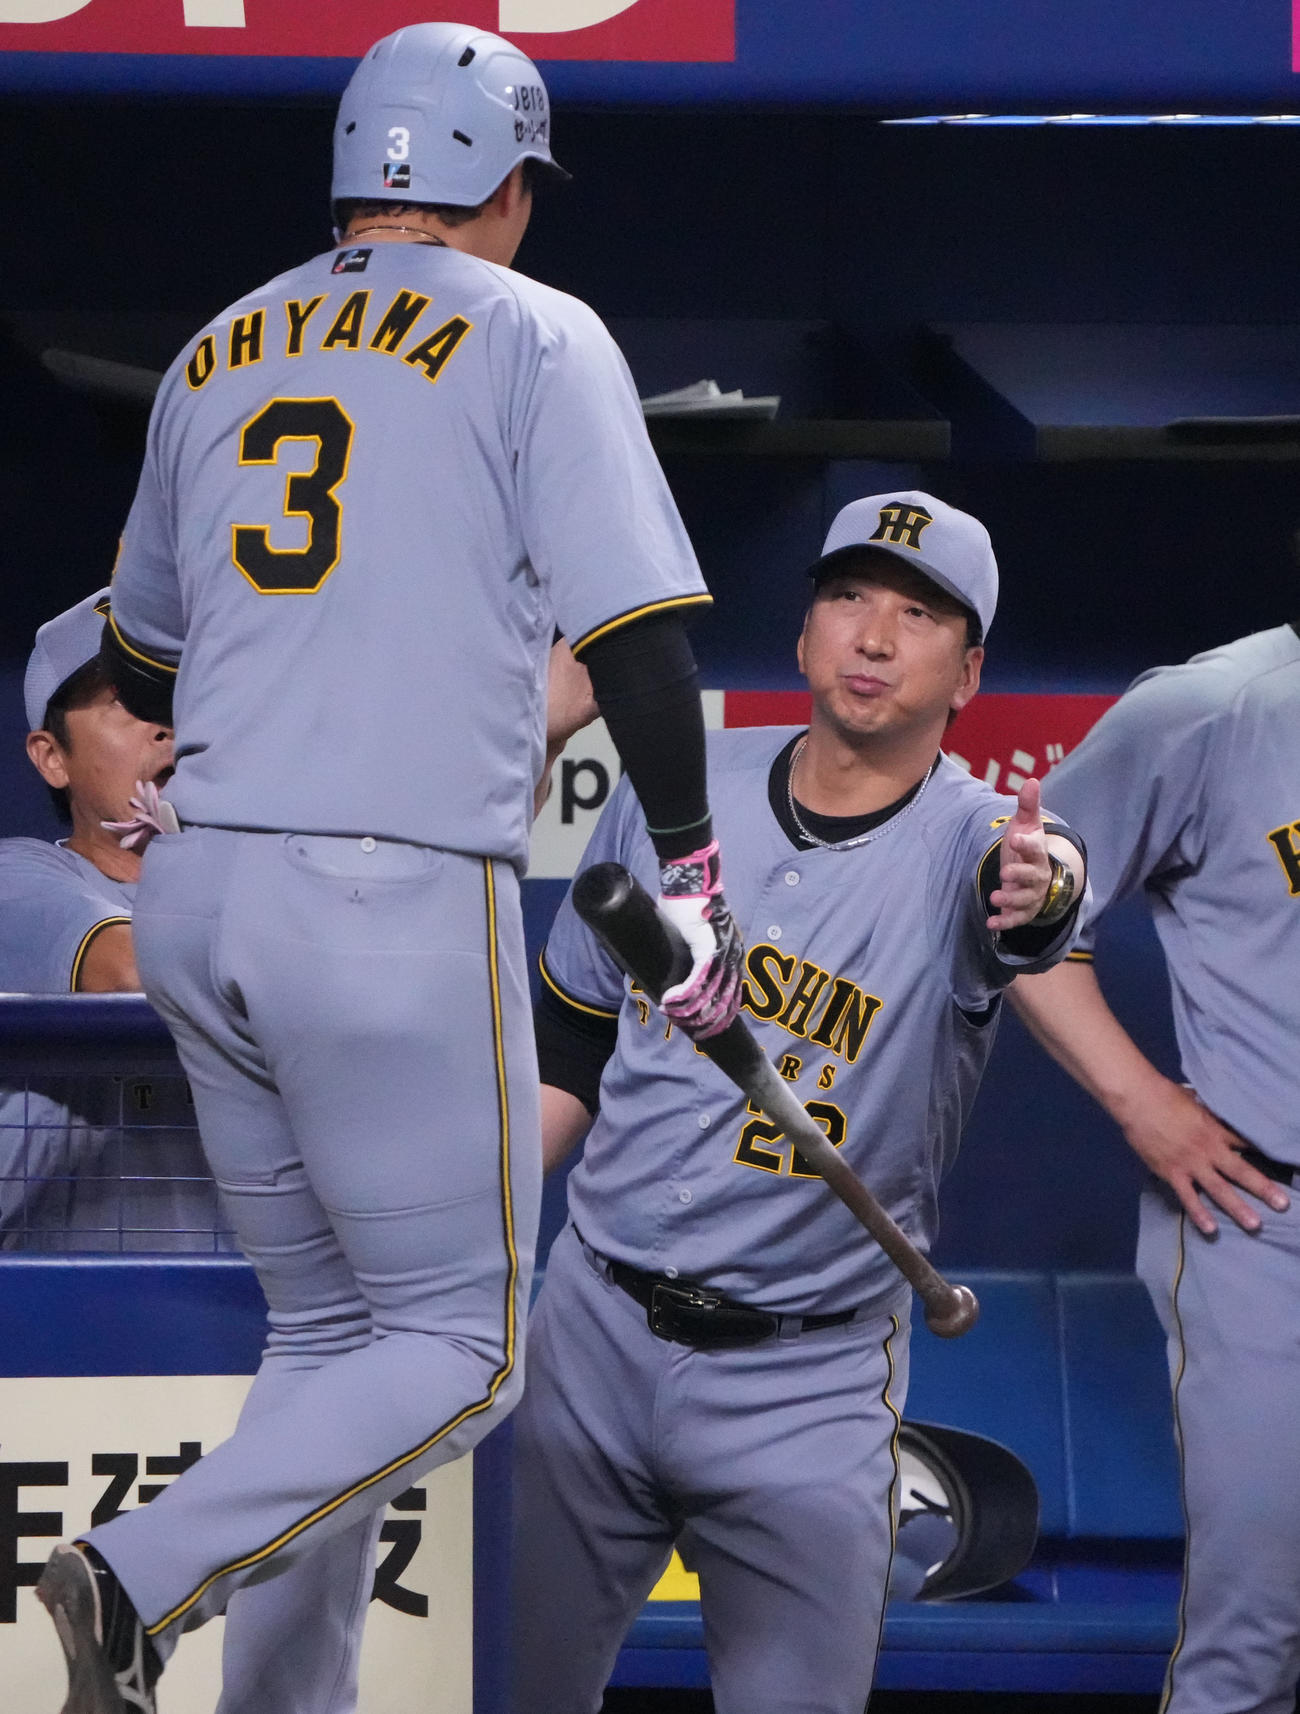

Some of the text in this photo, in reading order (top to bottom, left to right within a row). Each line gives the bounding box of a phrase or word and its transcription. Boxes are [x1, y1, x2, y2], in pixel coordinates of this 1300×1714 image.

[387, 126, 410, 160] 3
[185, 288, 474, 391] OHYAMA
[231, 396, 356, 594] 3
[631, 943, 883, 1064] SHIN
[733, 1098, 848, 1180] 22
